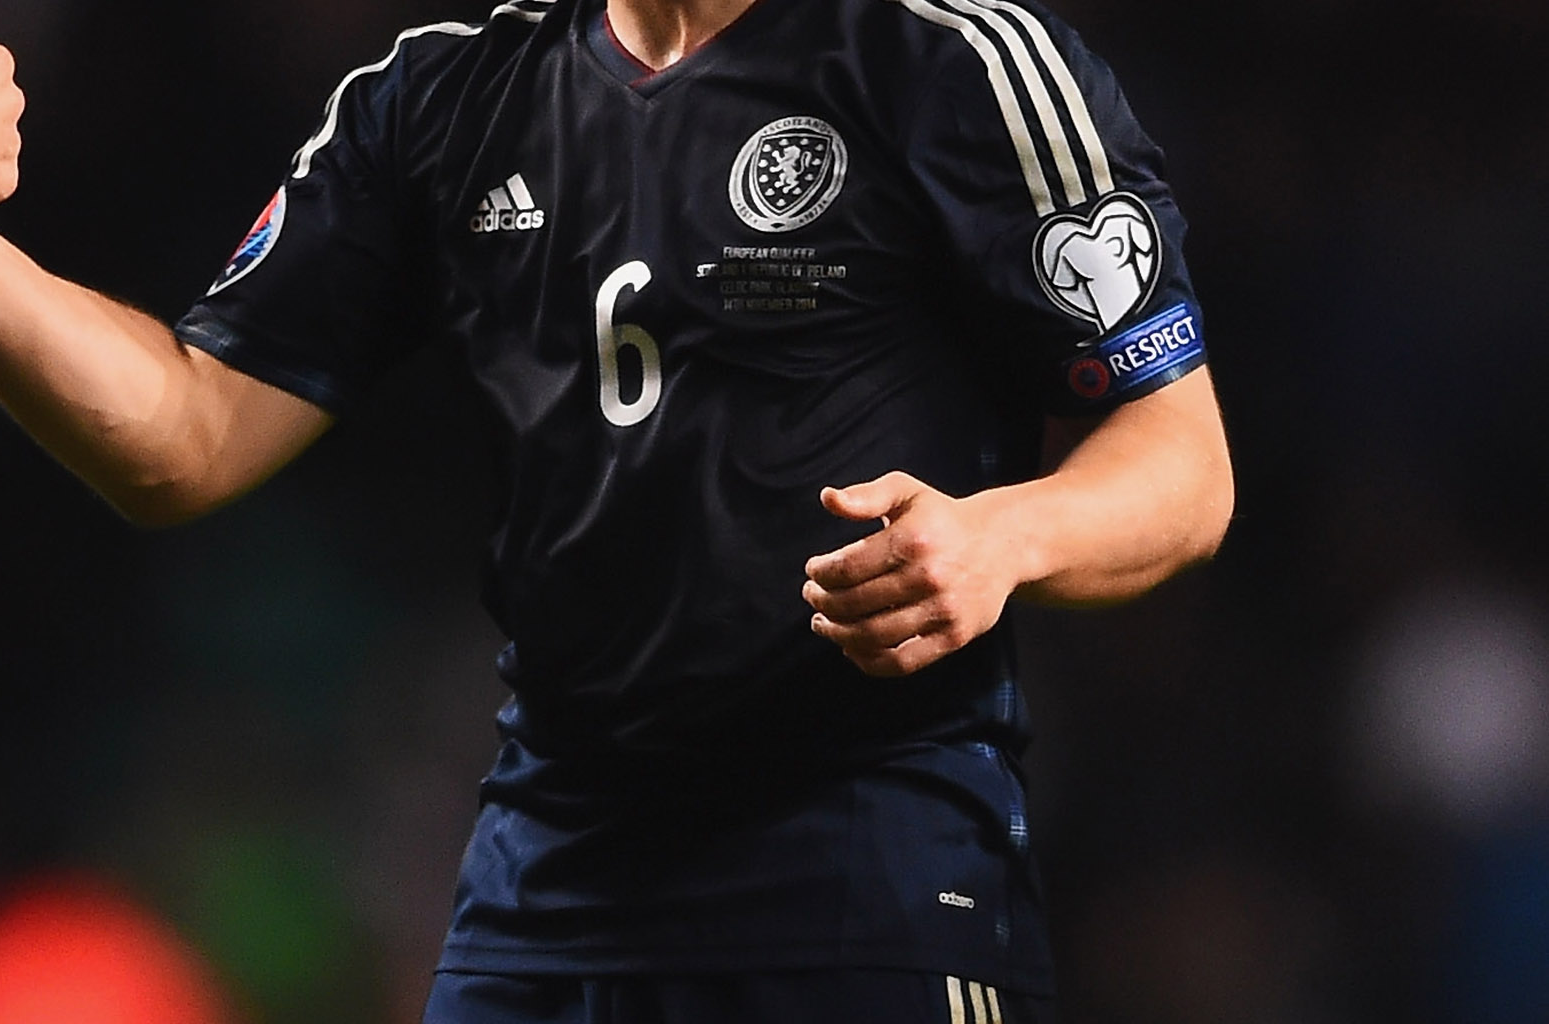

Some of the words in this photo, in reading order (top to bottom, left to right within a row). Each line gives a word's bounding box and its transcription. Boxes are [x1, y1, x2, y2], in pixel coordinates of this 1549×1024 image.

[470, 208, 544, 232] adidas
[807, 264, 847, 278] IRELAND
[595, 260, 661, 427] 6
[1108, 315, 1197, 377] RESPECT
